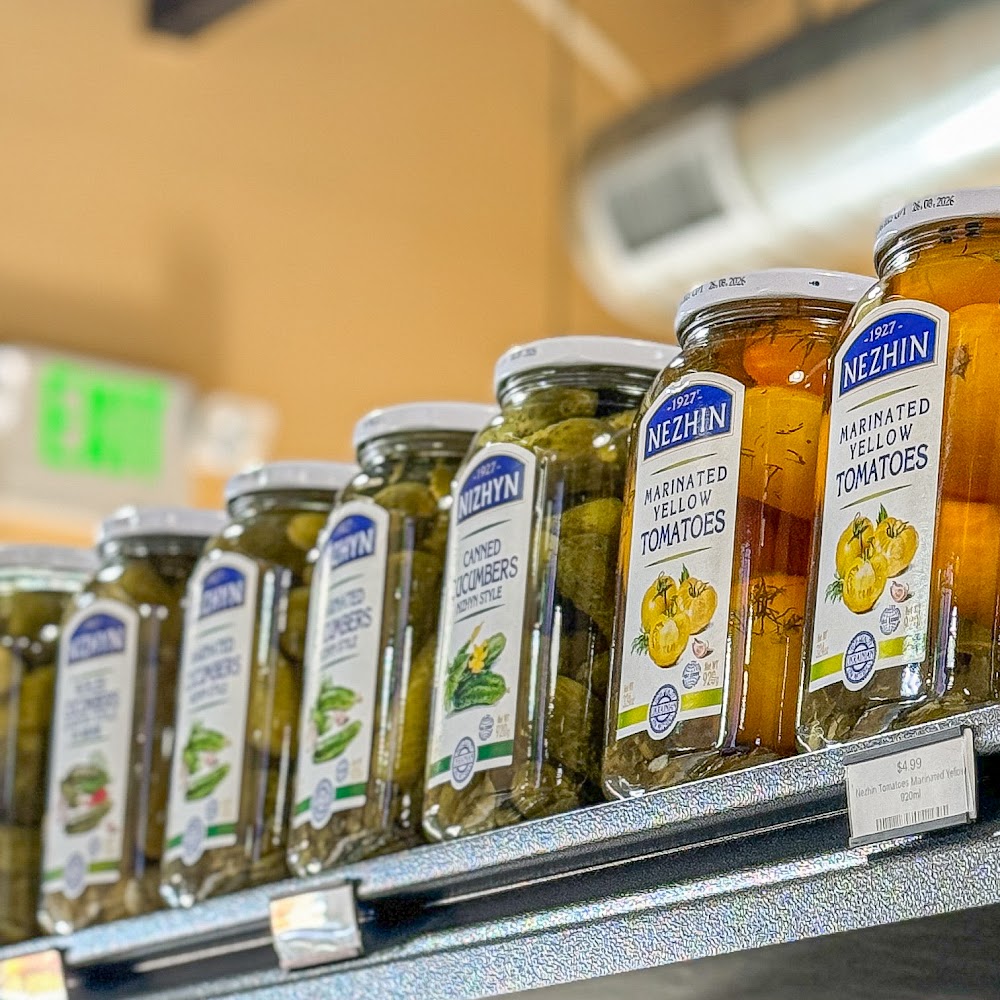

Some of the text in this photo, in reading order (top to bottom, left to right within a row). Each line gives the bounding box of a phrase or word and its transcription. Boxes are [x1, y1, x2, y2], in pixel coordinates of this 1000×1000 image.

[843, 331, 929, 389] NEZHIN
[648, 402, 726, 453] NEZHIN
[839, 398, 930, 445] MARINATED
[849, 423, 913, 460] YELLOW
[644, 466, 728, 506] MARINATED
[836, 443, 929, 498] TOMATOES
[458, 471, 520, 519] NIZHYN
[654, 489, 713, 522] YELLOW
[641, 509, 726, 556] TOMATOES
[463, 538, 501, 568] CANNED
[479, 585, 502, 606] STYLE
[897, 757, 922, 774] $4.99
[878, 779, 909, 793] Tomatoes
